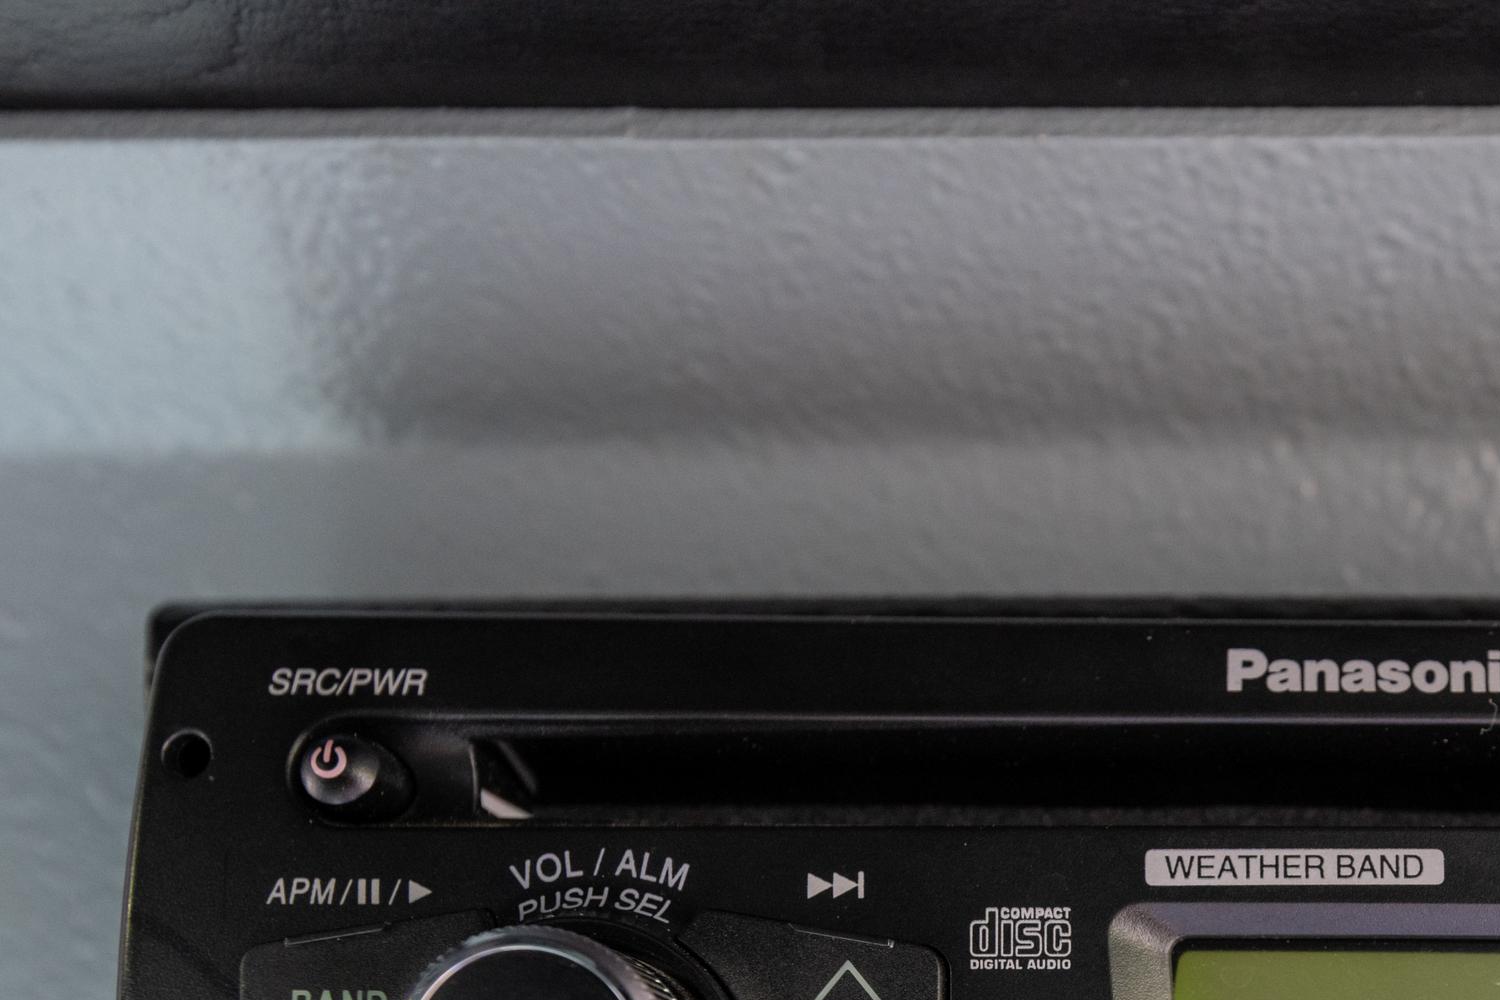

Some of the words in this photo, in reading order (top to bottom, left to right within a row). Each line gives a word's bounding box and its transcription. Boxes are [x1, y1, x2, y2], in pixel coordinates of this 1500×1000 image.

[268, 667, 428, 696] SRC/PWR
[509, 850, 583, 889] VOL
[615, 849, 690, 891] ALM
[1166, 855, 1331, 880] WEATHER
[1336, 855, 1425, 880] BAND
[518, 886, 609, 921] PUSH
[614, 888, 671, 923] SEL
[1000, 907, 1071, 919] COMPACT
[970, 959, 1023, 970] DIGITAL
[1027, 959, 1071, 970] AUDIO
